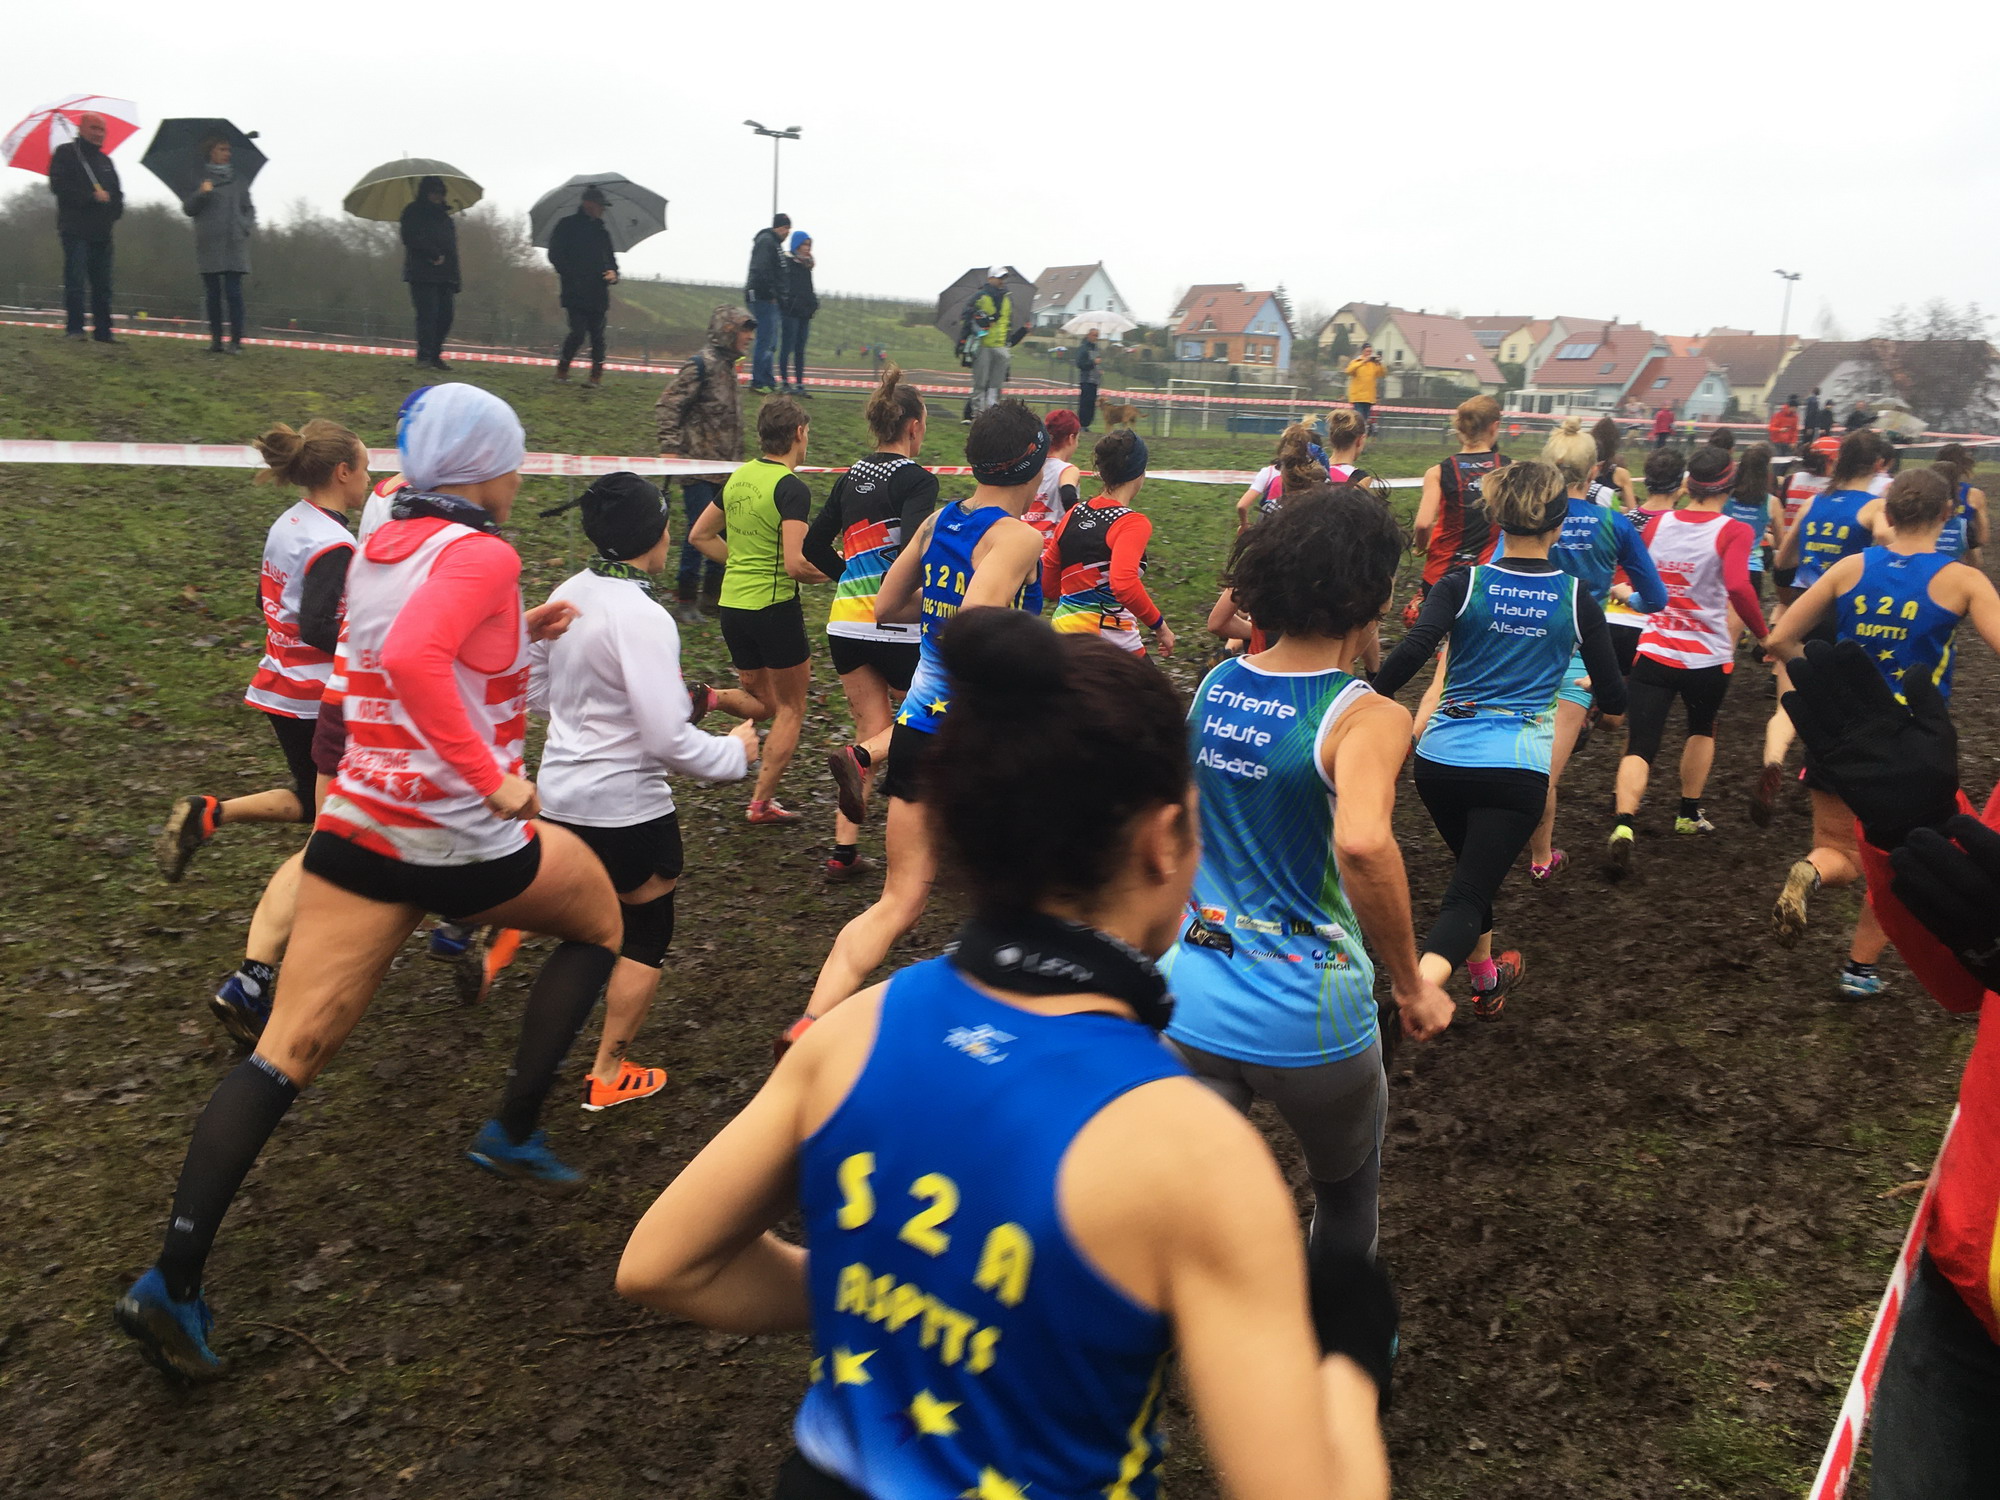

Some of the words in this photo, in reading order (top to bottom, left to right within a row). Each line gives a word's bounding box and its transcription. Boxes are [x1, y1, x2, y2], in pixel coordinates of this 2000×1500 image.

[1561, 528, 1591, 537] aute
[1806, 521, 1817, 536] S
[1820, 522, 1835, 536] 2
[924, 563, 932, 587] S
[936, 565, 950, 589] 2
[954, 571, 965, 596] A
[1488, 583, 1559, 602] Entente
[1493, 602, 1548, 619] Haute
[1854, 595, 1867, 615] S
[1876, 596, 1894, 615] 2
[1901, 600, 1918, 621] A
[1488, 620, 1547, 637] Alsace
[1856, 622, 1908, 640] ASPTTS
[1206, 684, 1297, 719] Entente
[1203, 714, 1271, 747] Haute
[1196, 746, 1269, 780] Alsace
[1314, 961, 1350, 971] BIANCHI
[836, 1151, 877, 1231] S
[897, 1171, 961, 1259] 2
[972, 1222, 1035, 1309] A
